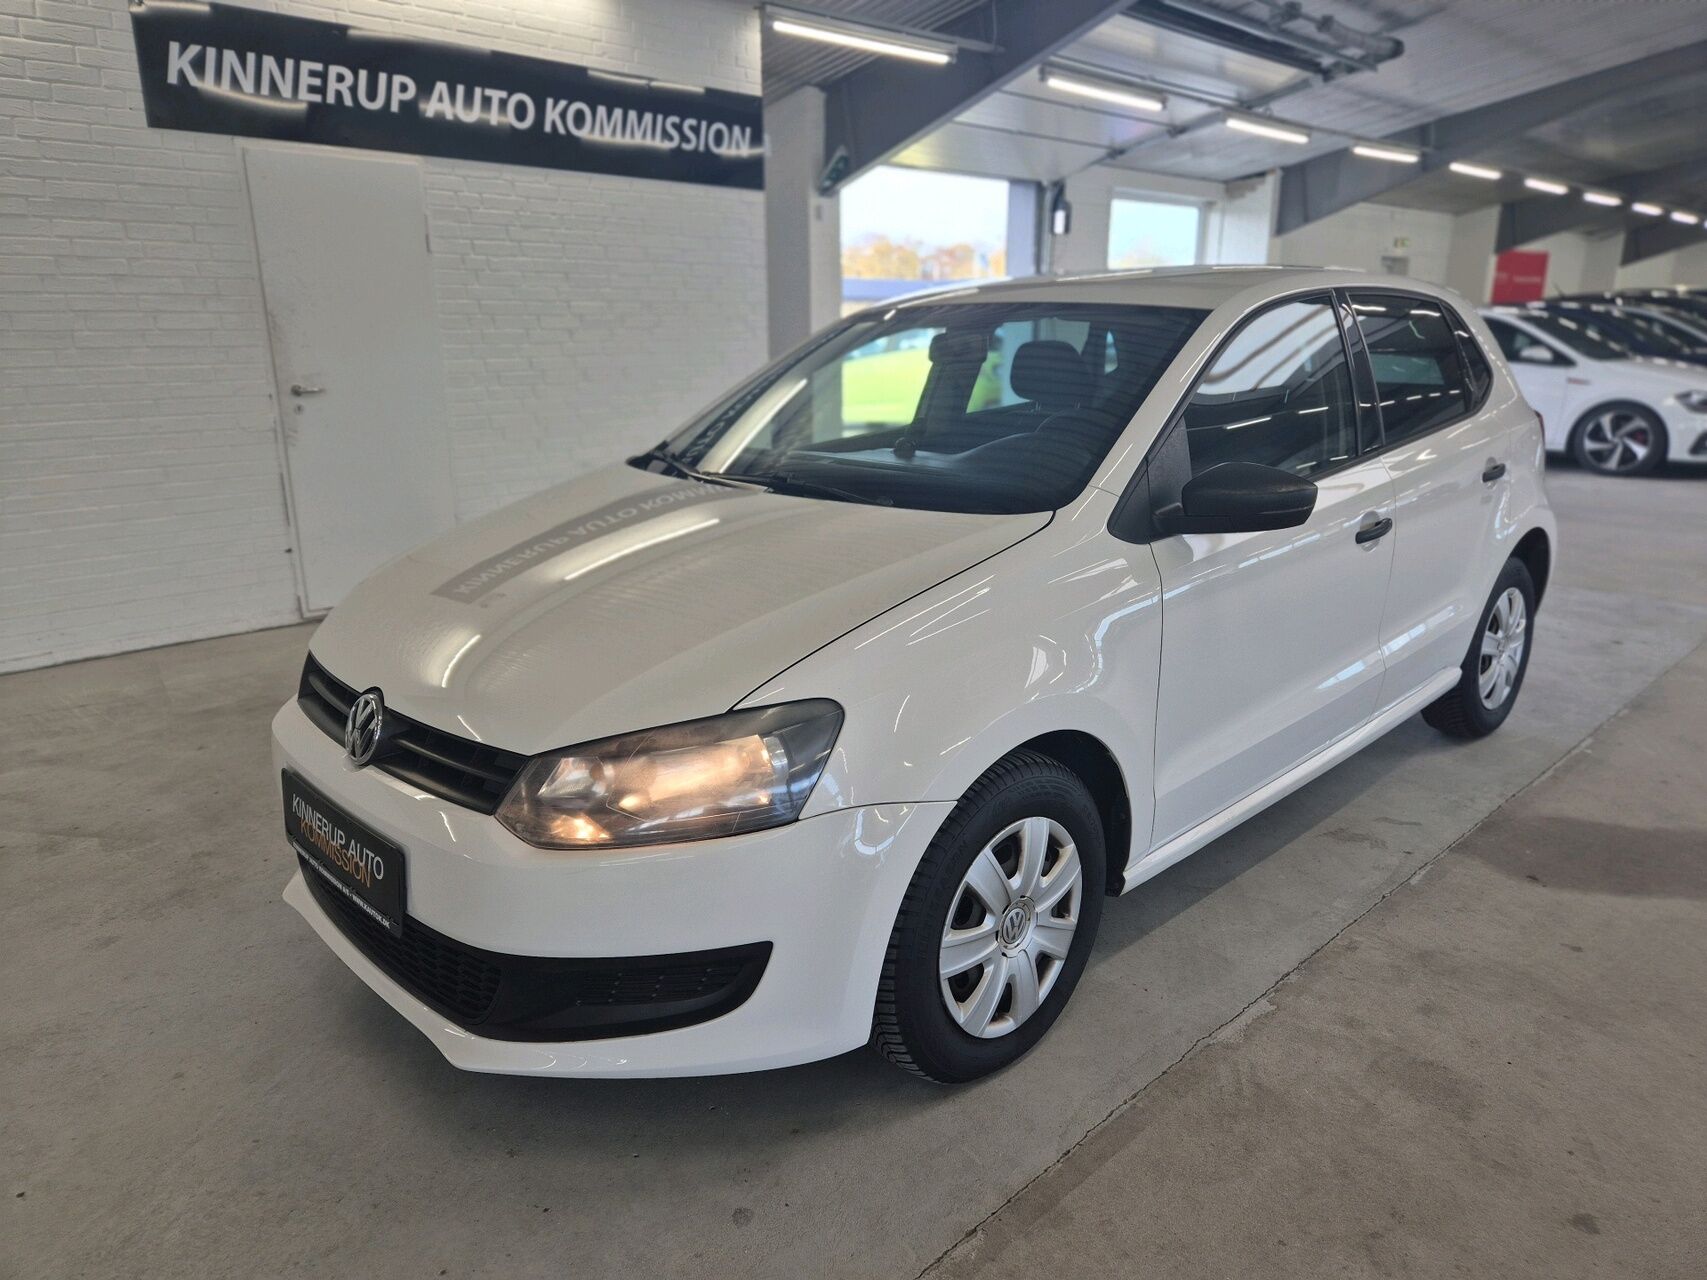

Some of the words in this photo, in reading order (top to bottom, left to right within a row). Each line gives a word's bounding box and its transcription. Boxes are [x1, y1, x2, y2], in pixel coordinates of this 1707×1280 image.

[166, 41, 417, 114] KINNERUP
[425, 81, 536, 130] AUTO
[544, 99, 752, 158] KOMMISSION
[292, 793, 346, 847] KINNERUP
[347, 839, 384, 881] AUTO
[300, 819, 372, 888] KOMMISSION
